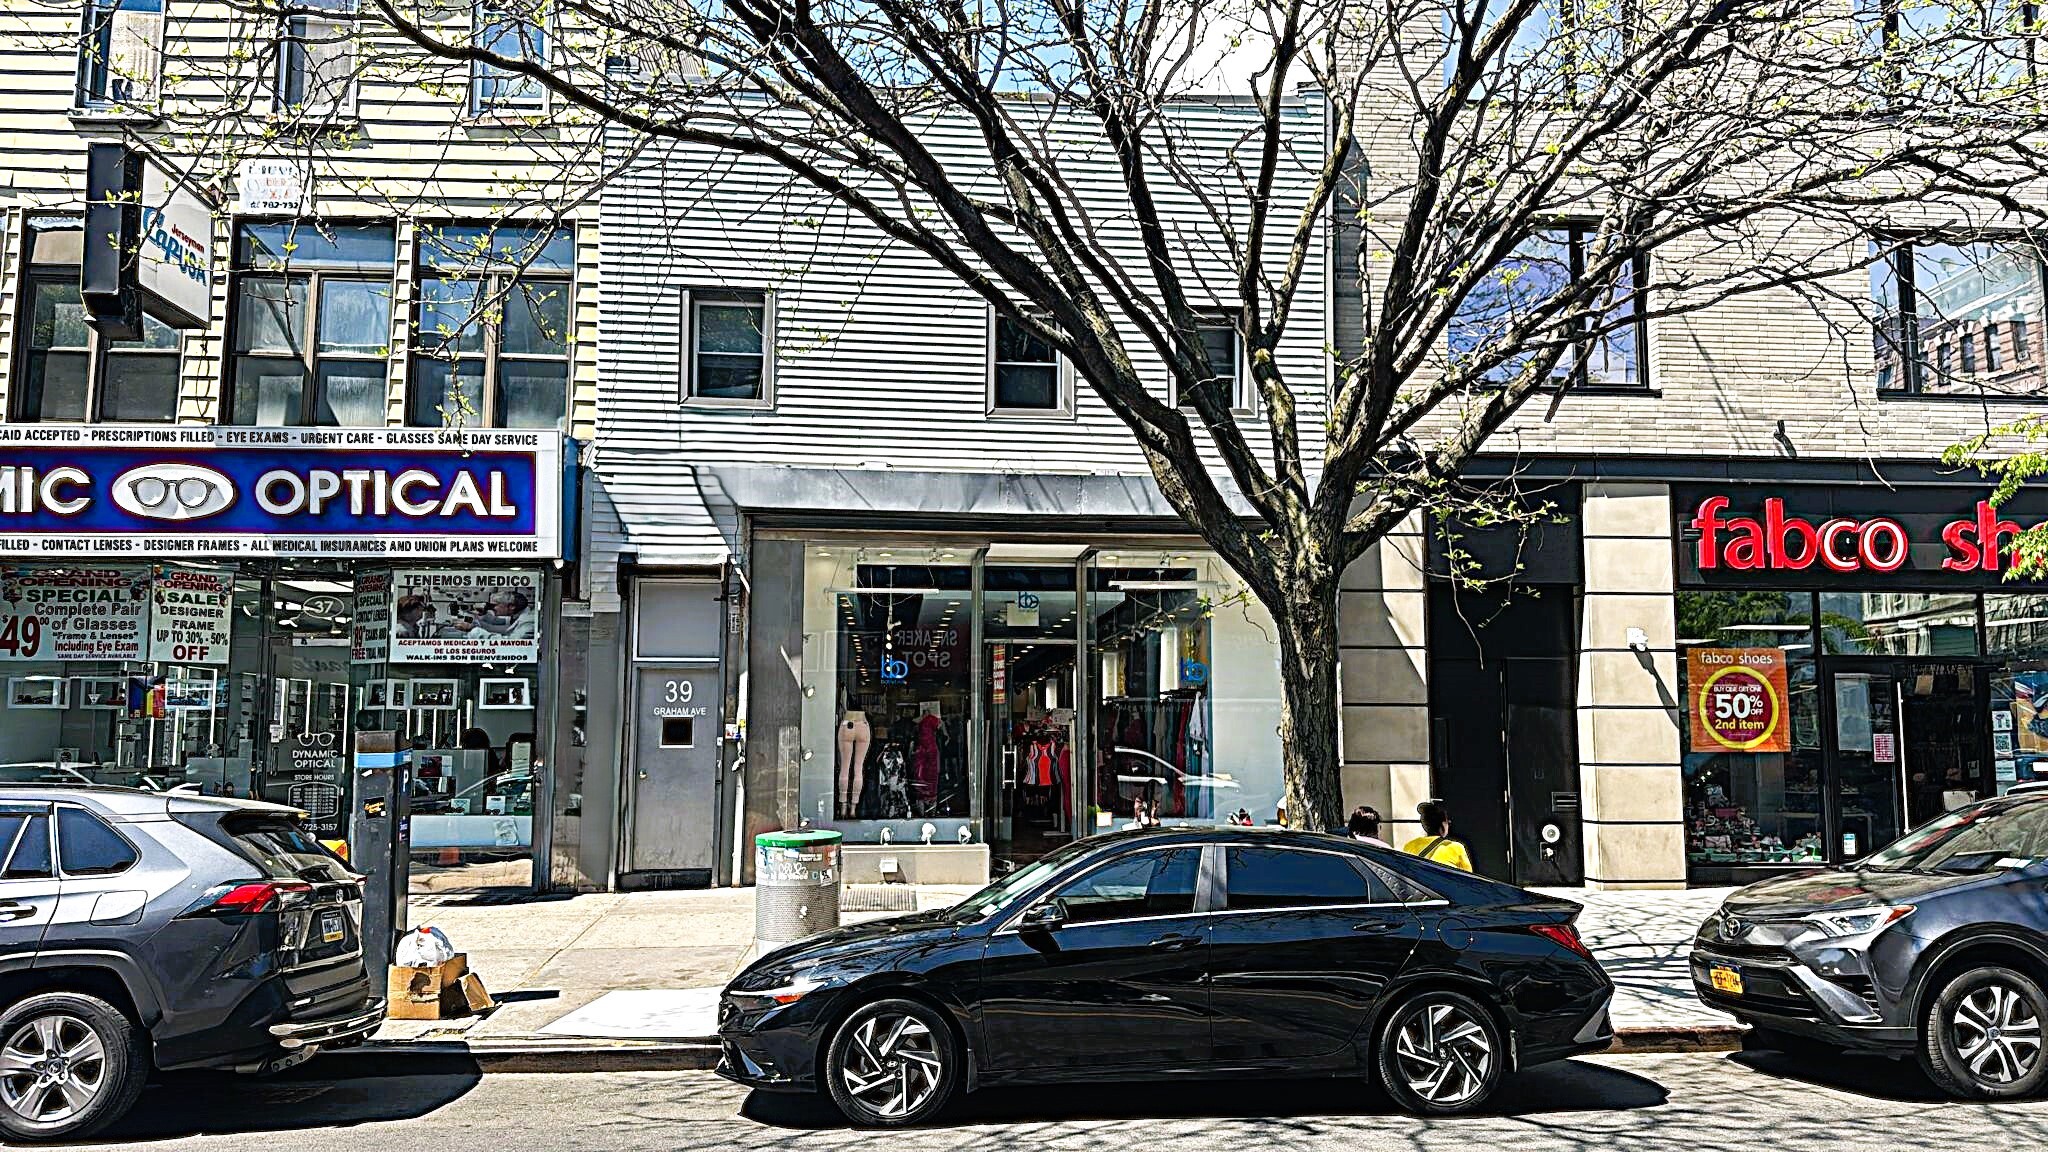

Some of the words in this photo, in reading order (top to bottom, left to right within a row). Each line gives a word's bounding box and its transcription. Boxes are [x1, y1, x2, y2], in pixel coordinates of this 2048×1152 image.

[171, 223, 205, 254] Jerseyman
[24, 429, 81, 442] ACCEPTED
[91, 430, 177, 443] PRESCRIPTIONS
[180, 430, 215, 443] FILLED
[226, 431, 247, 443] EYE
[249, 431, 289, 444] EXAMS
[300, 432, 344, 445] URGENT
[346, 432, 375, 445] CARE
[386, 432, 435, 445] GLASSES
[437, 432, 469, 446] SAME
[471, 433, 492, 446] DAY
[494, 433, 539, 447] SERVICE
[254, 468, 516, 516] OPTICAL
[1692, 495, 1909, 572] fabco
[0, 539, 30, 551] ILLED
[41, 539, 91, 551] CONTACT
[93, 539, 133, 551] LENSES
[143, 539, 195, 551] DESIGNER
[197, 540, 240, 551] FRAMES
[250, 540, 270, 551] ALL
[272, 540, 318, 552] MEDICAL
[320, 540, 387, 552] INSURANCES
[389, 541, 412, 552] AND
[414, 541, 447, 552] UNION
[449, 541, 485, 552] PLANS
[487, 541, 538, 553] WELCOME
[32, 569, 121, 578] GRAND
[170, 571, 218, 583] GRAND
[403, 574, 472, 586] TENEMOS
[475, 574, 531, 586] MEDICO
[18, 577, 133, 587] OPENING
[163, 580, 224, 592] OPENING
[26, 589, 126, 603] SPECIAL
[166, 592, 219, 606] SALE
[360, 594, 382, 607] SPECIAL
[34, 602, 107, 618] Complete
[111, 602, 142, 616] Pair
[160, 606, 224, 618] DESIGNER
[314, 600, 334, 614] 37
[51, 617, 68, 631] of
[73, 617, 137, 631] Glasses
[171, 619, 215, 631] FRAME
[90, 632, 98, 640] &
[156, 630, 169, 643] UP
[172, 631, 183, 643] TO
[184, 632, 204, 645] 30%
[210, 632, 229, 646] 50%
[54, 640, 95, 653] Including
[96, 641, 113, 653] Eye
[114, 641, 139, 651] Exam
[172, 644, 210, 661] OFF
[351, 647, 366, 660] FREE
[1701, 651, 1734, 665] fabco
[1738, 652, 1773, 664] shoes
[664, 679, 694, 703] 39
[653, 706, 689, 716] GRAHAM
[690, 706, 707, 716] AVE
[1750, 708, 1764, 716] OFF
[1714, 718, 1736, 730] 2nd
[1739, 719, 1764, 730] item
[292, 749, 339, 759] DYNAMIC
[294, 759, 336, 768] OPTICAL
